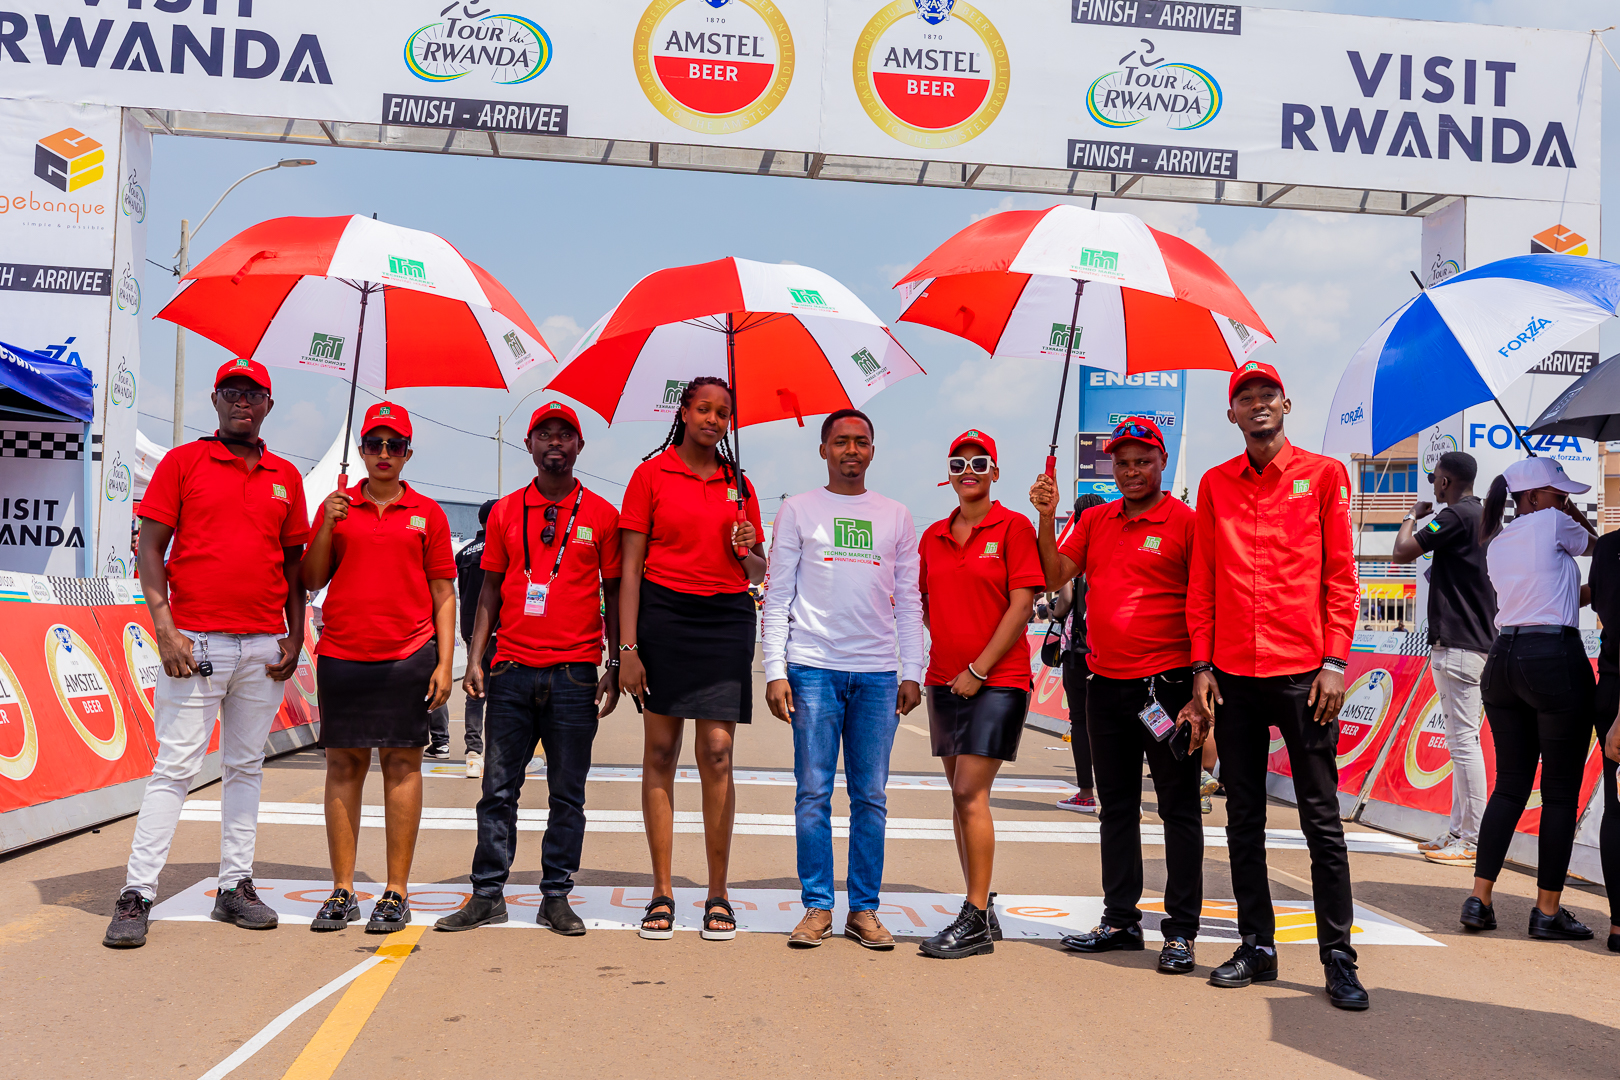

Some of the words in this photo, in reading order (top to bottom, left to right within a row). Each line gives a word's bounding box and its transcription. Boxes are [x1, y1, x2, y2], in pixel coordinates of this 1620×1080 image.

[861, 2, 907, 50] PREMIUM
[962, 6, 990, 31] BEER
[1076, 0, 1139, 24] FINISH
[1158, 4, 1237, 31] ARRIVEE
[0, 11, 334, 85] RWANDA
[509, 31, 525, 44] du
[664, 30, 765, 57] AMSTEL
[923, 33, 943, 41] 1870
[422, 41, 530, 68] RWANDA
[883, 46, 981, 74] AMSTEL
[638, 44, 663, 102] BREWED
[666, 104, 681, 119] TO
[689, 117, 713, 130] THE
[723, 104, 772, 130] AMSTEL
[771, 23, 793, 99] TRADITION
[689, 63, 739, 81] BEER
[1346, 50, 1517, 108] VISIT
[857, 61, 881, 117] BREWED
[885, 120, 900, 134] TO
[906, 132, 931, 145] THE
[940, 119, 988, 145] AMSTEL
[988, 39, 1008, 115] TRADITION
[907, 79, 955, 98] BEER
[1182, 80, 1197, 91] du
[388, 97, 456, 125] FINISH
[477, 103, 563, 132] ARRIVEE
[1103, 89, 1202, 115] RWANDA
[1281, 102, 1578, 169] RWANDA
[1072, 143, 1135, 169] FINISH
[1154, 149, 1233, 175] ARRIVEE
[32, 268, 104, 292] ARRIVEE
[1071, 265, 1097, 273] TECHNO
[1098, 269, 1125, 277] MARKET
[1090, 372, 1178, 387] ENGEN
[848, 551, 872, 559] MARKET
[64, 673, 103, 693] AMSTEL
[82, 699, 104, 714] BEER
[1341, 704, 1376, 721] AMSTEL
[1340, 724, 1360, 736] BEER
